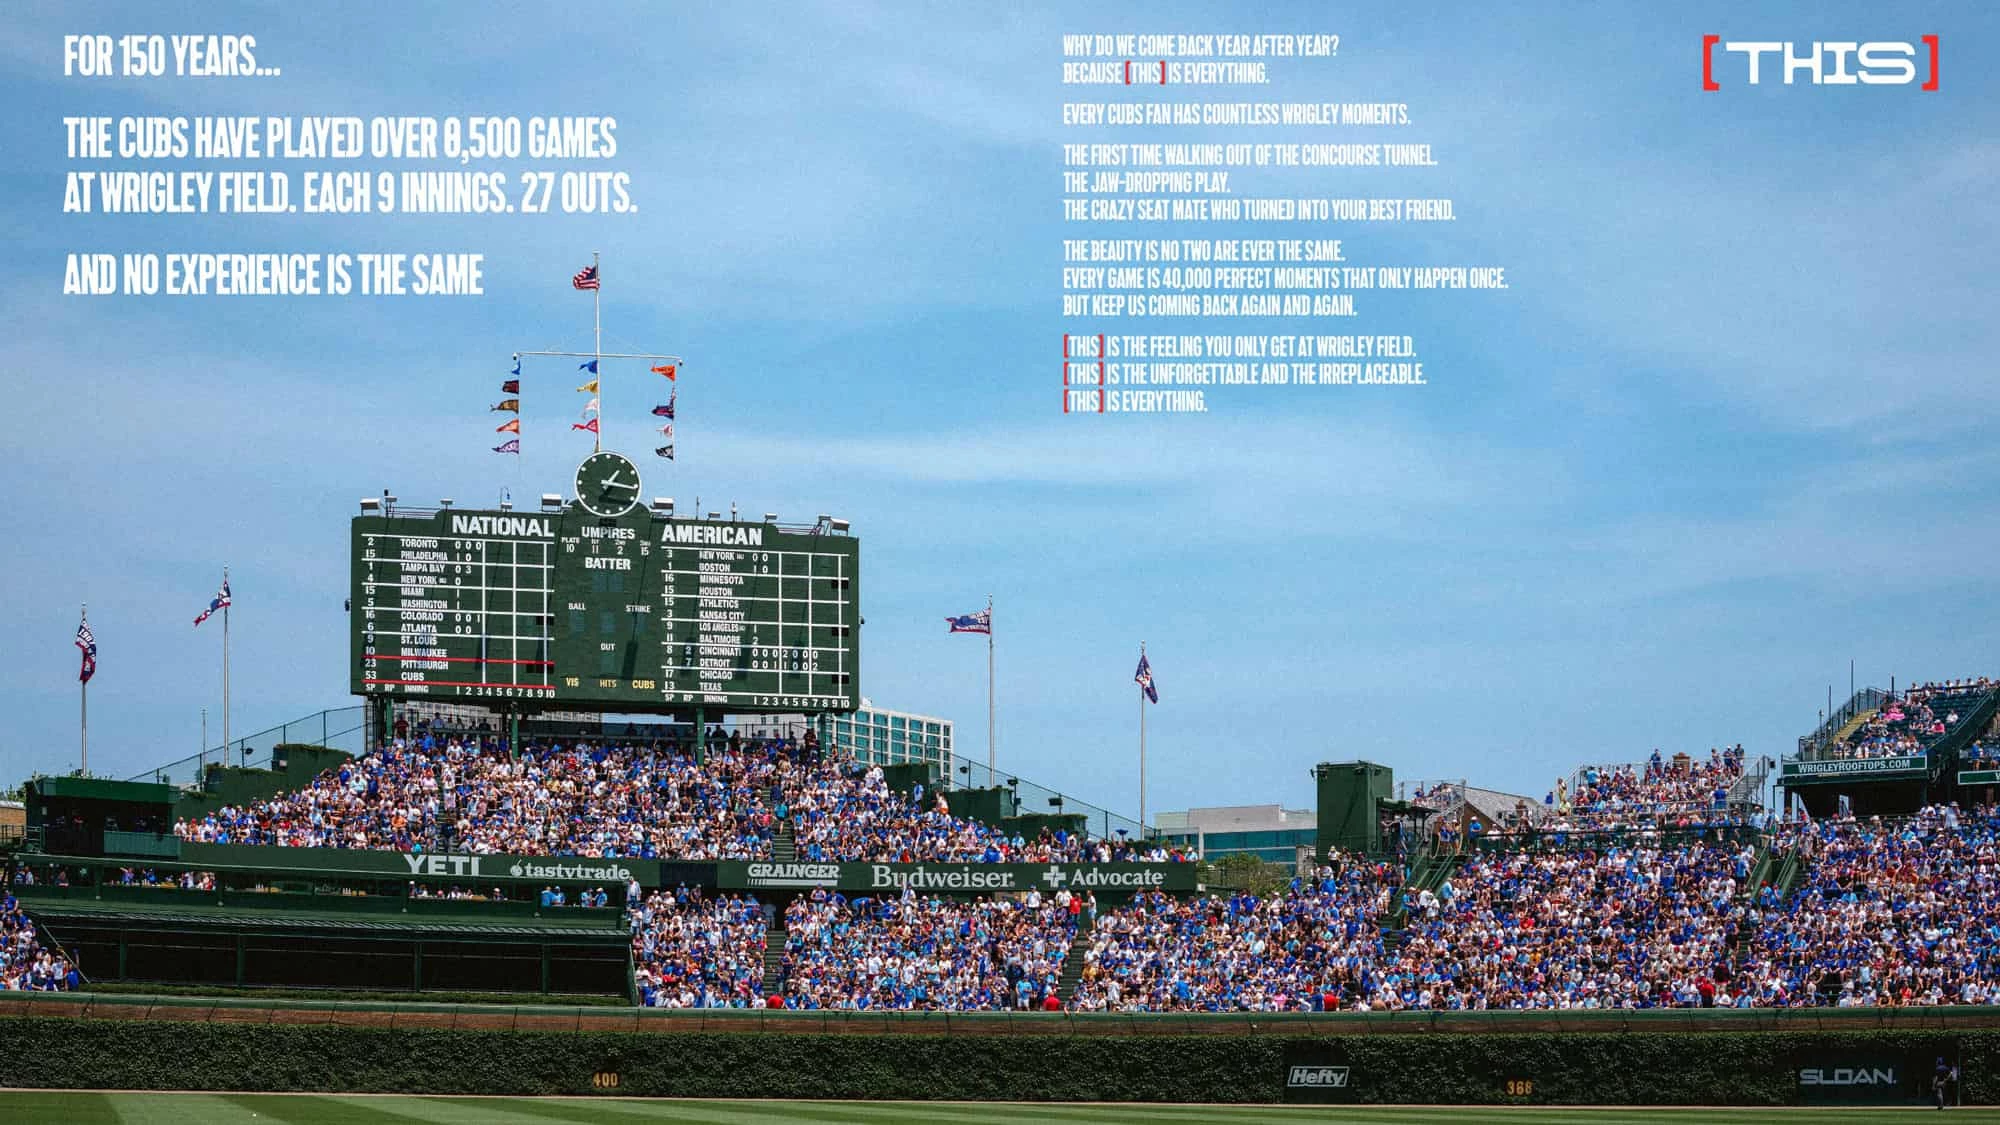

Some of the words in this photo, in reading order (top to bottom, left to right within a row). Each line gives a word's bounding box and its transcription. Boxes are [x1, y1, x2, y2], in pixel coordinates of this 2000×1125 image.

[453, 515, 554, 536] NATIONAL
[582, 526, 635, 539] UMPIRES
[662, 525, 762, 545] AMERICAN
[401, 539, 437, 548] TORONTO
[401, 551, 448, 561] PHILADELPHIA
[699, 551, 715, 559] NEW
[716, 552, 734, 560] YORK
[401, 563, 427, 572] TAMPA
[429, 564, 445, 573] BAY
[585, 557, 631, 570] BATTER
[699, 564, 730, 572] BOSTON
[401, 575, 416, 584] NEW
[418, 576, 437, 584] YORK
[700, 576, 743, 585] MINNESOTA
[401, 588, 424, 596] MIAMI
[699, 588, 732, 596] HOUSTON
[401, 600, 447, 609] WASHINGTON
[699, 600, 739, 608] ATHLETICS
[626, 605, 650, 613] STRIKE
[401, 612, 443, 622] COLORADO
[699, 611, 727, 619] KANSAS
[729, 612, 744, 620] CITY
[401, 624, 437, 633] ATLANTA
[699, 623, 710, 631] LOS
[712, 624, 739, 632] ANGELES
[415, 637, 437, 646] LOUIS
[699, 635, 740, 644] BALTIMORE
[401, 648, 447, 657] MILWAUKEE
[699, 647, 741, 656] CINCINNATI
[401, 660, 448, 670] PITTSBURGH
[699, 659, 729, 667] DETROIT
[401, 672, 424, 681] CUBS
[700, 671, 732, 680] CHICAGO
[566, 678, 579, 687] VIS
[600, 680, 616, 688] HITS
[632, 680, 655, 688] CUBS
[700, 682, 722, 691] TEXAS
[404, 854, 481, 876] YETI
[524, 863, 630, 880] tastytrade
[748, 863, 839, 878] GRAINGER
[872, 865, 1013, 887] Budweiser
[1072, 867, 1164, 886] Advocate
[593, 1072, 618, 1087] 400
[1291, 1069, 1345, 1087] Hefty
